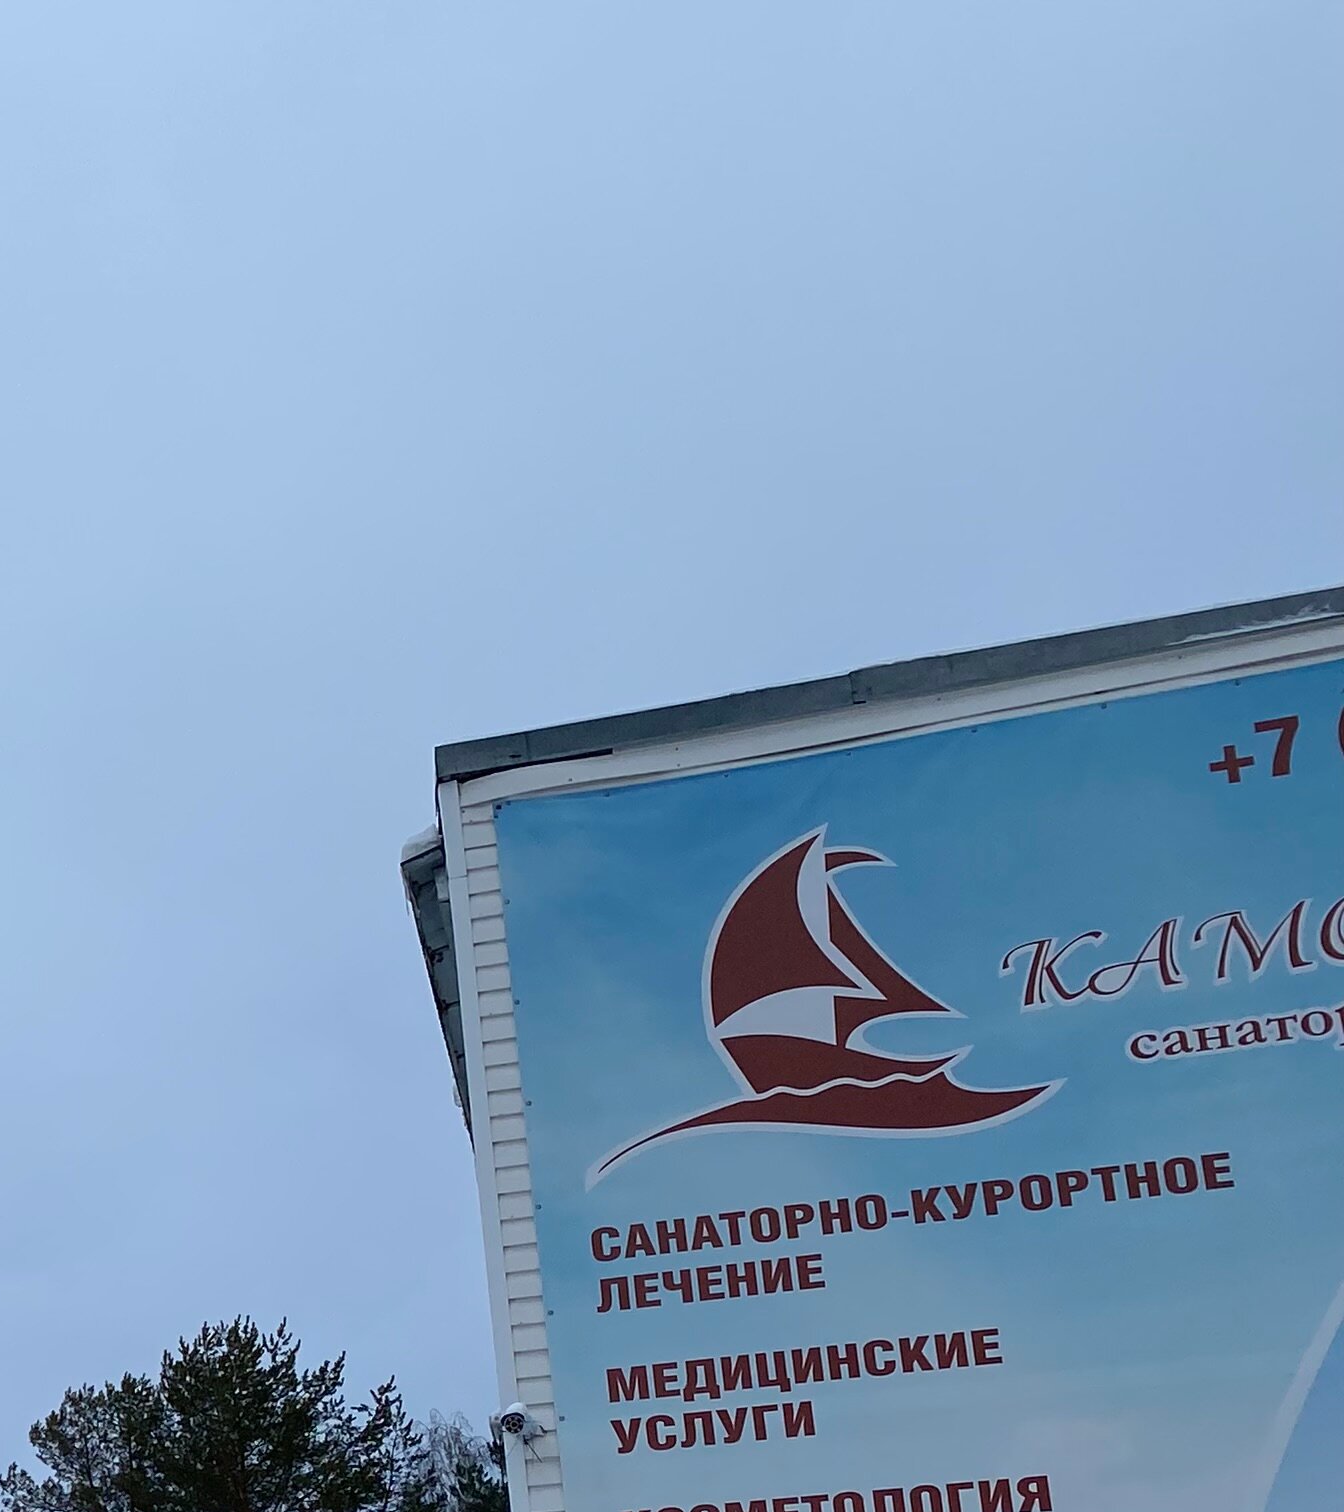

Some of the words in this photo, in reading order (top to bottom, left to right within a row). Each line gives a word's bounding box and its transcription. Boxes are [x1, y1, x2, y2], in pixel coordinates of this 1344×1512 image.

[1209, 715, 1299, 784] +7
[590, 1151, 1236, 1263] САНАТОРНО-КУРОРТНОЕ
[596, 1252, 827, 1314] ЛЕЧЕНИЕ
[605, 1327, 1004, 1404] МЕДИЦИНСКИЕ
[609, 1399, 817, 1455] УСЛУГИ
